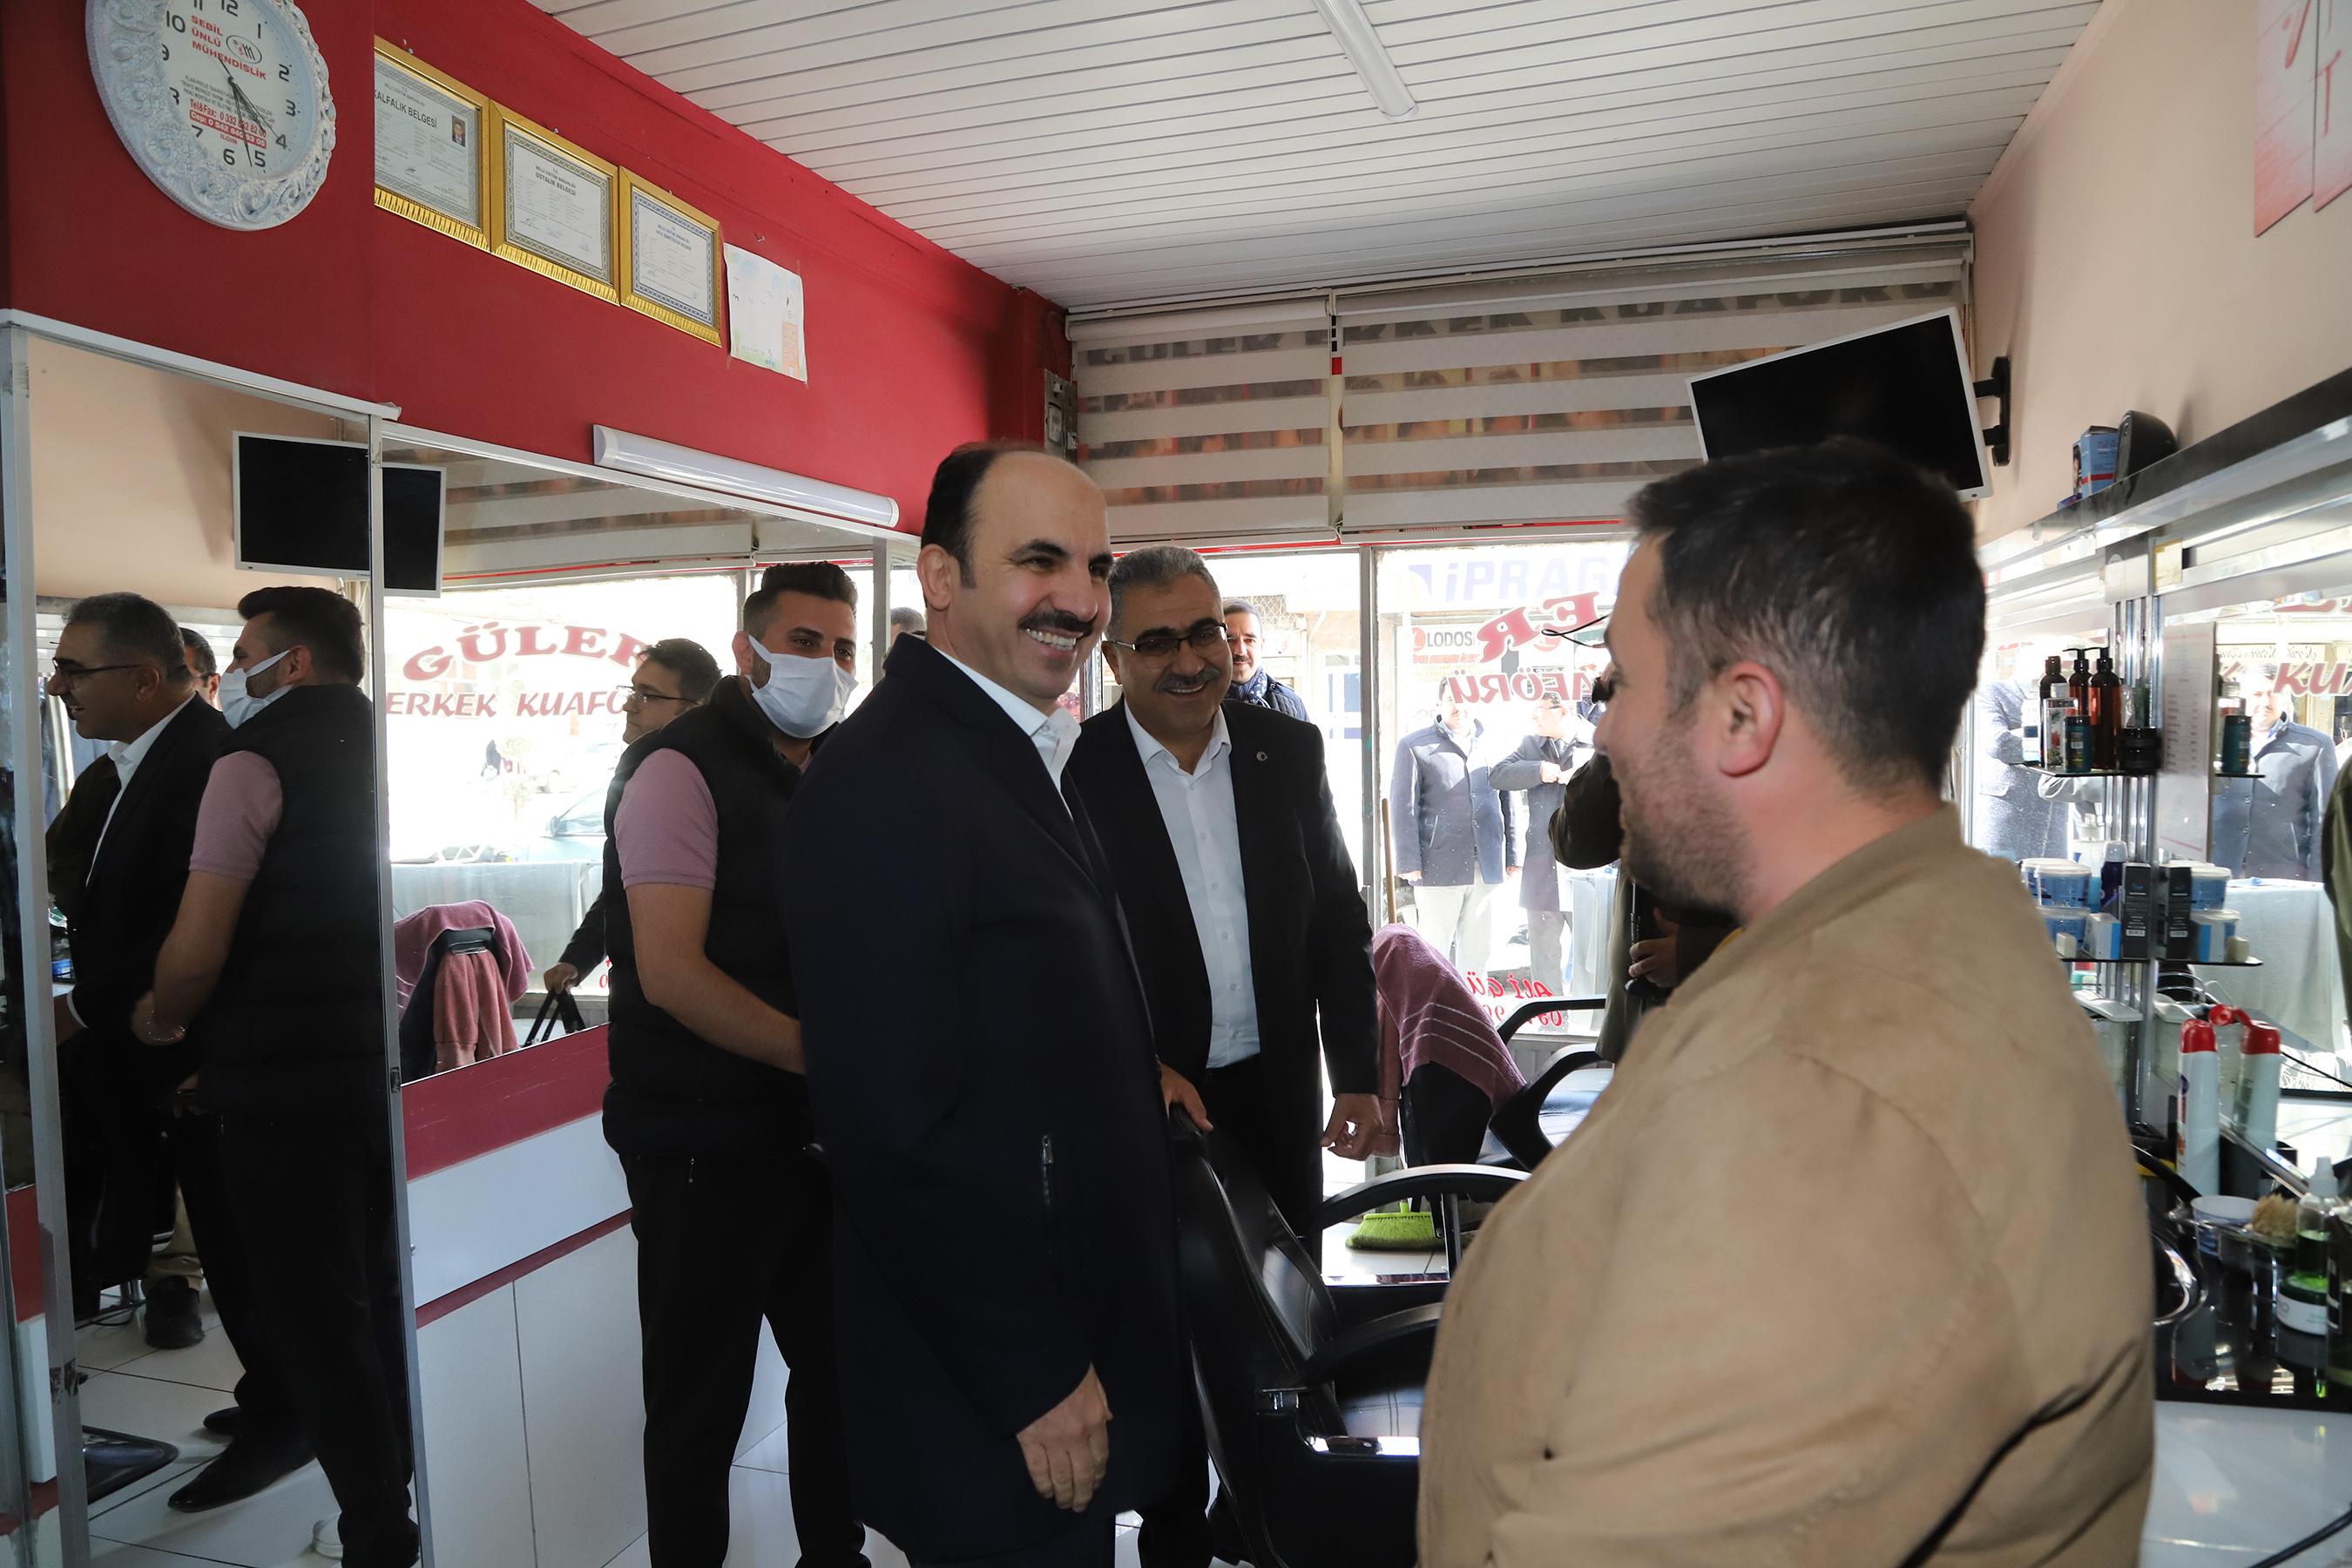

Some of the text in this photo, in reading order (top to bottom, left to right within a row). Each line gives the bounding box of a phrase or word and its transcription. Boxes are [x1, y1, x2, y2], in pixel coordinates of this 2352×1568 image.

[221, 0, 239, 17] 12
[166, 10, 186, 33] 10
[191, 15, 223, 37] SEBİL
[257, 23, 261, 39] 1
[192, 27, 221, 48] ÜNLÜ
[161, 44, 170, 61] 9
[192, 40, 267, 80] MÜHENDİSLİK
[278, 63, 290, 83] 2
[190, 98, 217, 118] Tel&Fax:
[220, 112, 225, 121] 0
[225, 114, 237, 126] 332
[286, 99, 296, 118] 3
[408, 106, 437, 129] BELGESİ
[191, 112, 206, 124] Cep:
[256, 137, 266, 147] 05
[191, 125, 204, 138] 7
[275, 133, 287, 150] 4
[222, 148, 236, 166] 6
[254, 150, 266, 168] 5
[386, 691, 497, 719] ERKEK
